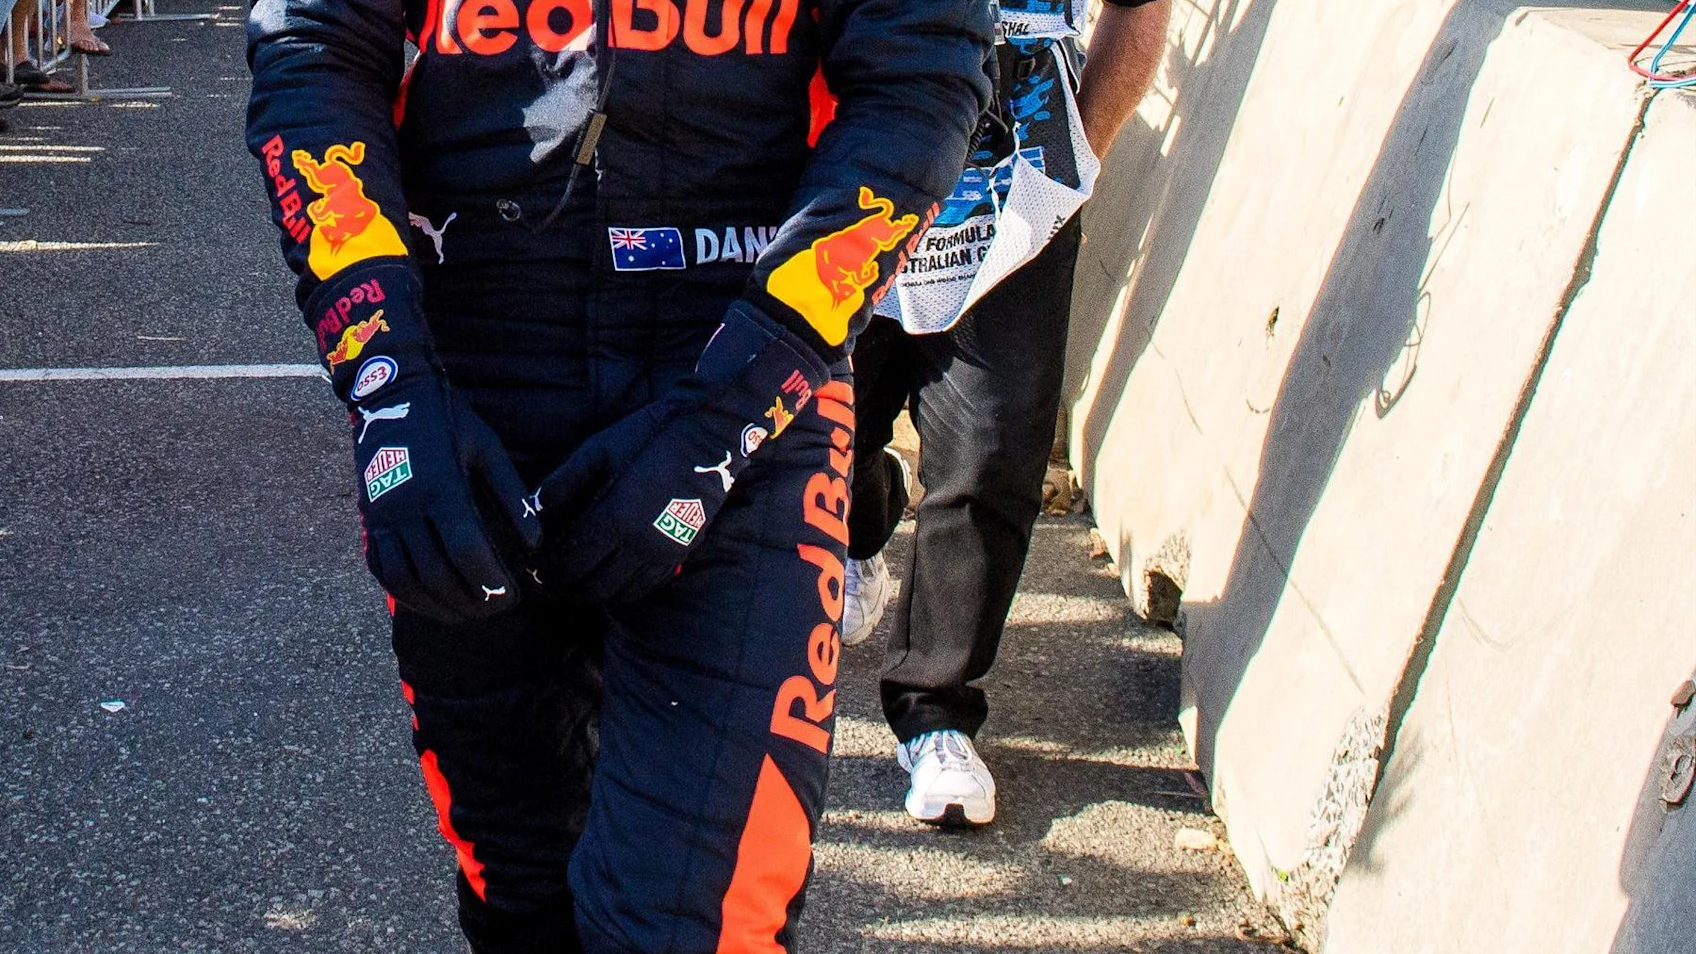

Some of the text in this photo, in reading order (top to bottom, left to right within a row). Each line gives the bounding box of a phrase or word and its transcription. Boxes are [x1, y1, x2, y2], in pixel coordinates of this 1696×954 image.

[260, 134, 313, 246] Red Bull
[695, 227, 777, 264] DAN
[903, 246, 974, 274] TRALIAN
[336, 278, 386, 324] Red
[366, 450, 405, 481] HEUER
[370, 466, 407, 497] TAG
[659, 513, 693, 543] TAG
[770, 543, 847, 754] Red
